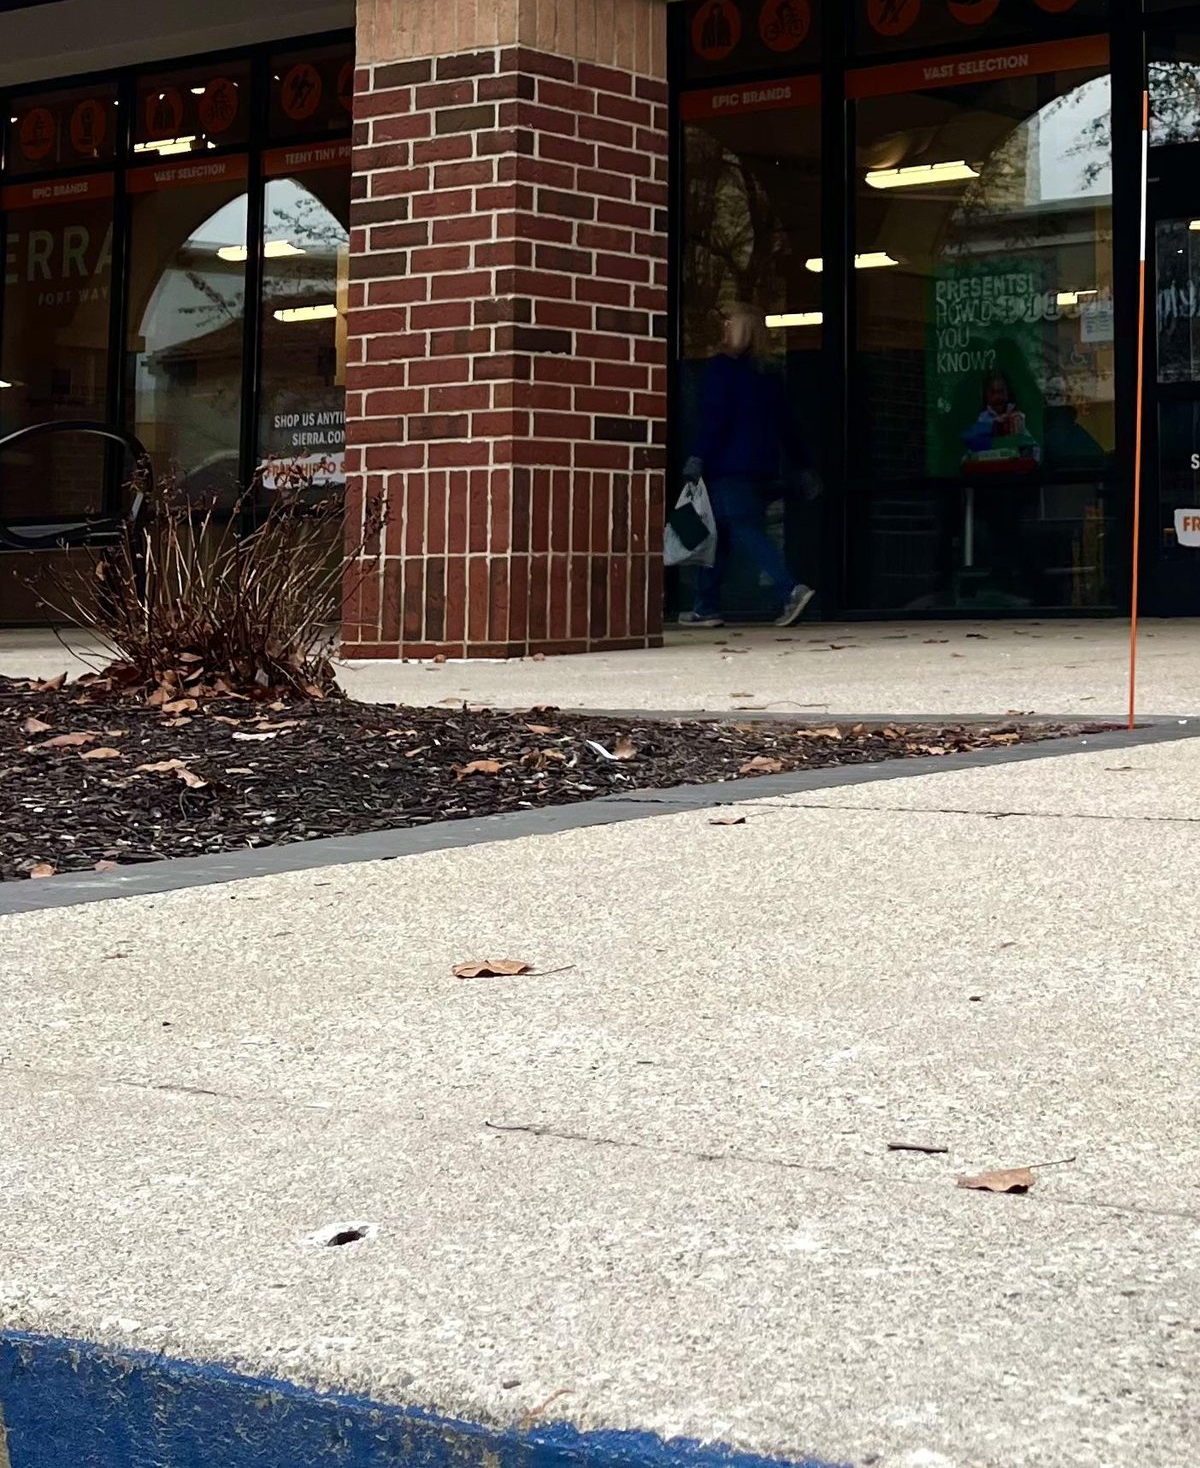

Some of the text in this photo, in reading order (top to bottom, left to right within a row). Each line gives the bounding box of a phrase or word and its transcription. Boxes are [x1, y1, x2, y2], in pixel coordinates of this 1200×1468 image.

[923, 54, 1029, 81] VAST SELECTION
[712, 85, 792, 109] EPIC BRANDS
[314, 148, 335, 162] TINY
[154, 163, 226, 183] VAST SELECTION
[936, 273, 1034, 300] PRESENTS!
[936, 326, 970, 349] YOU
[937, 349, 996, 374] KNOW?
[274, 411, 346, 428] SHOP US ANYTI
